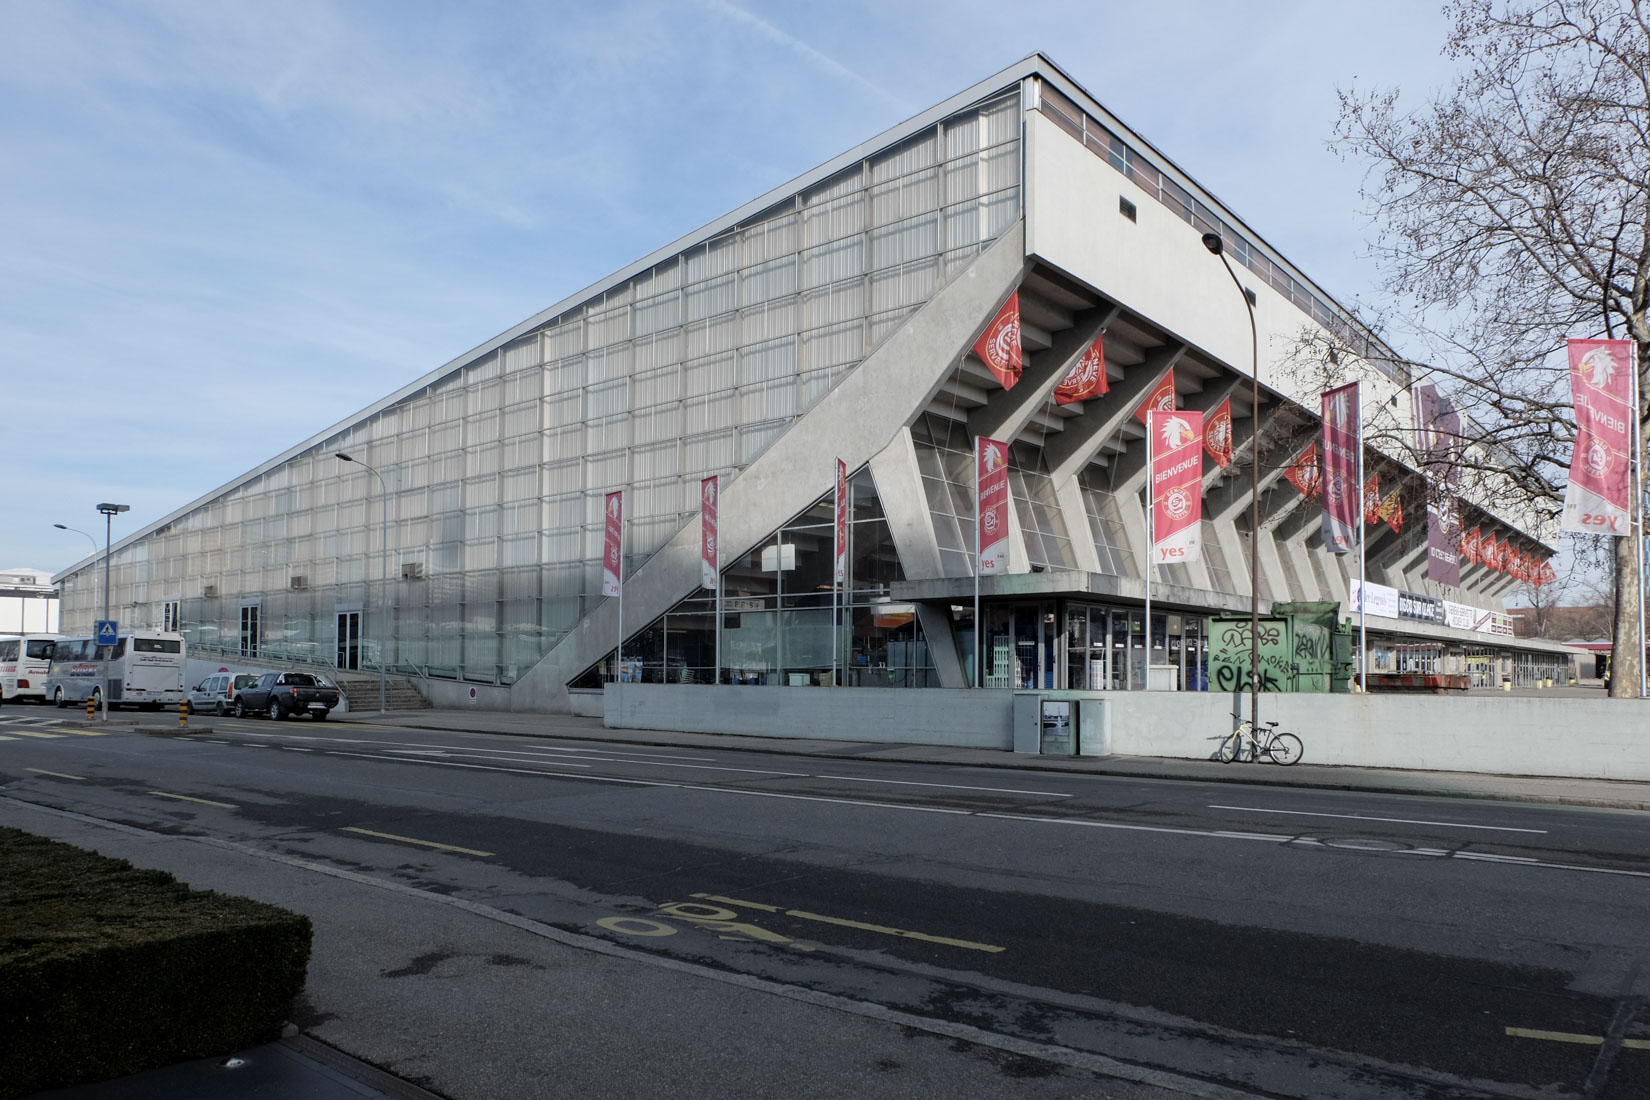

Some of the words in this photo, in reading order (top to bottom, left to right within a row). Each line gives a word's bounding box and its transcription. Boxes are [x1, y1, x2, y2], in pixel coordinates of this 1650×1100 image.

[1155, 455, 1199, 484] BIENVENUE
[1161, 547, 1184, 560] yes
[981, 559, 995, 571] yes
